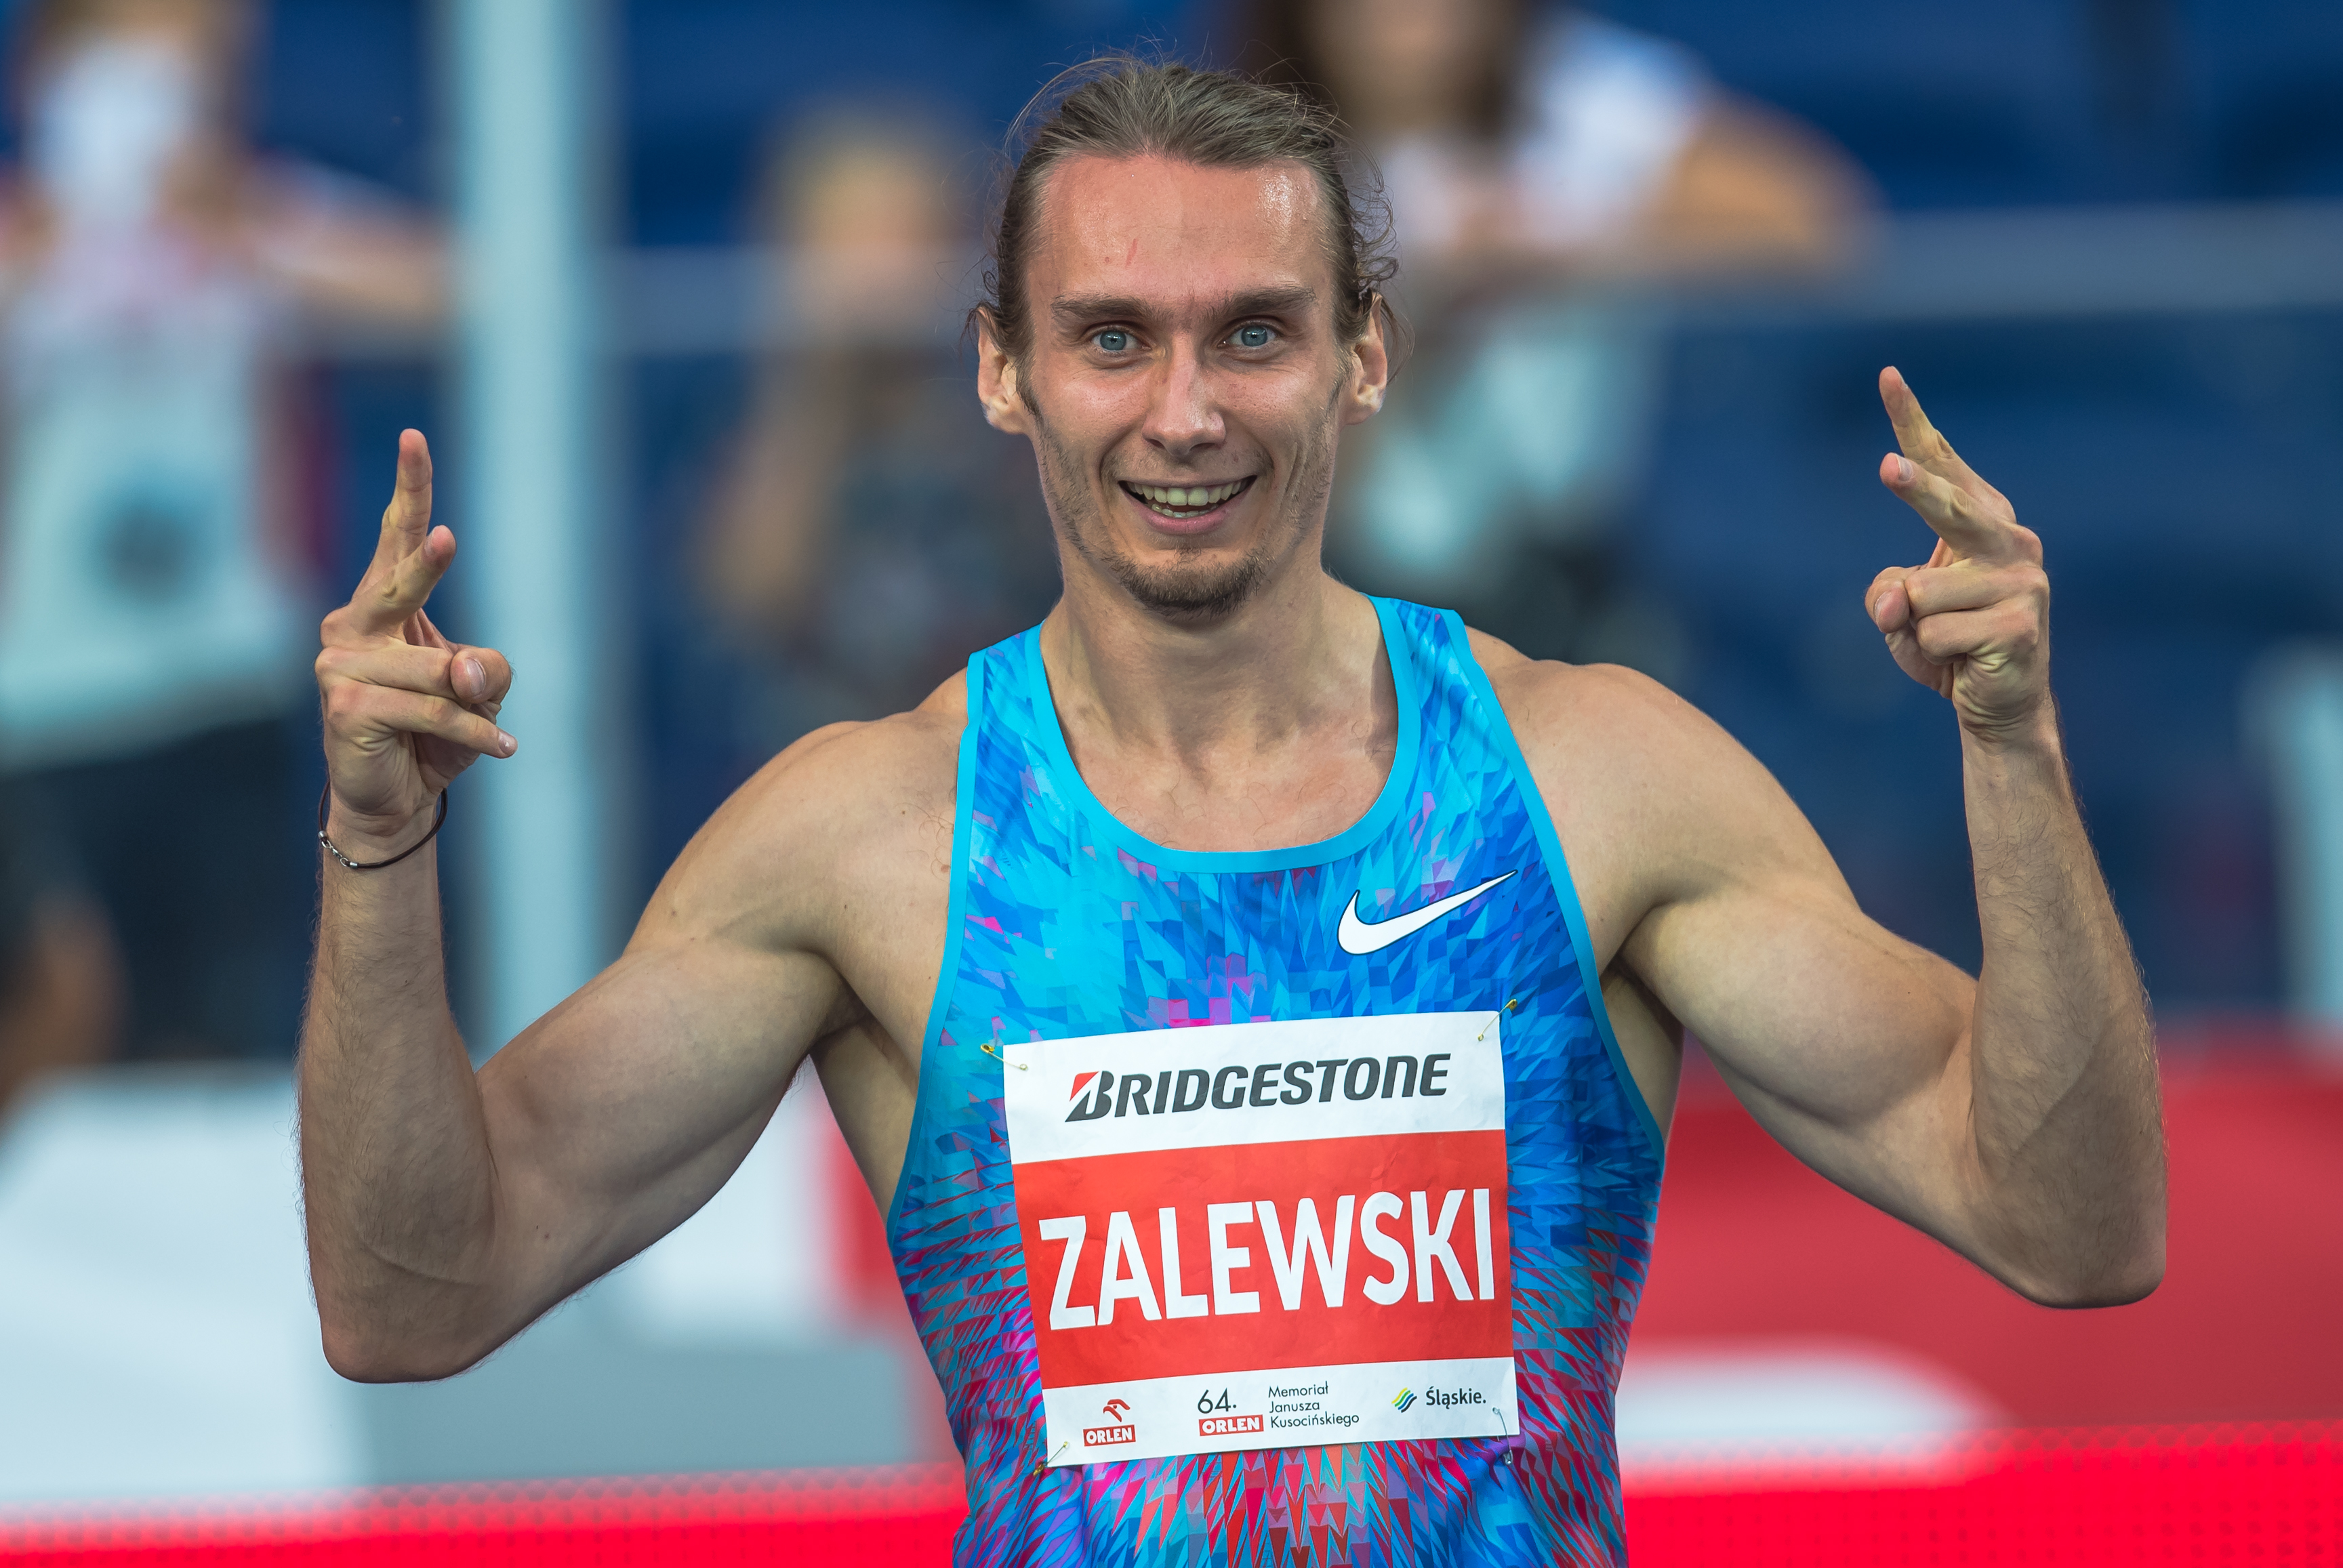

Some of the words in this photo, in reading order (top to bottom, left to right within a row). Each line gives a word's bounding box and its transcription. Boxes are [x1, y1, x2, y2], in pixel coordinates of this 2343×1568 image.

[1065, 1053, 1451, 1122] BRIDGESTONE
[1039, 1188, 1496, 1330] ZALEWSKI
[1268, 1380, 1329, 1398] Memoriał
[1425, 1386, 1486, 1409] Śląskie.
[1197, 1387, 1237, 1414] 64.
[1269, 1401, 1320, 1414] Janusza
[1202, 1417, 1260, 1435] ORLEN
[1270, 1411, 1360, 1428] Kusocińskiego
[1086, 1426, 1133, 1445] ORLEN
